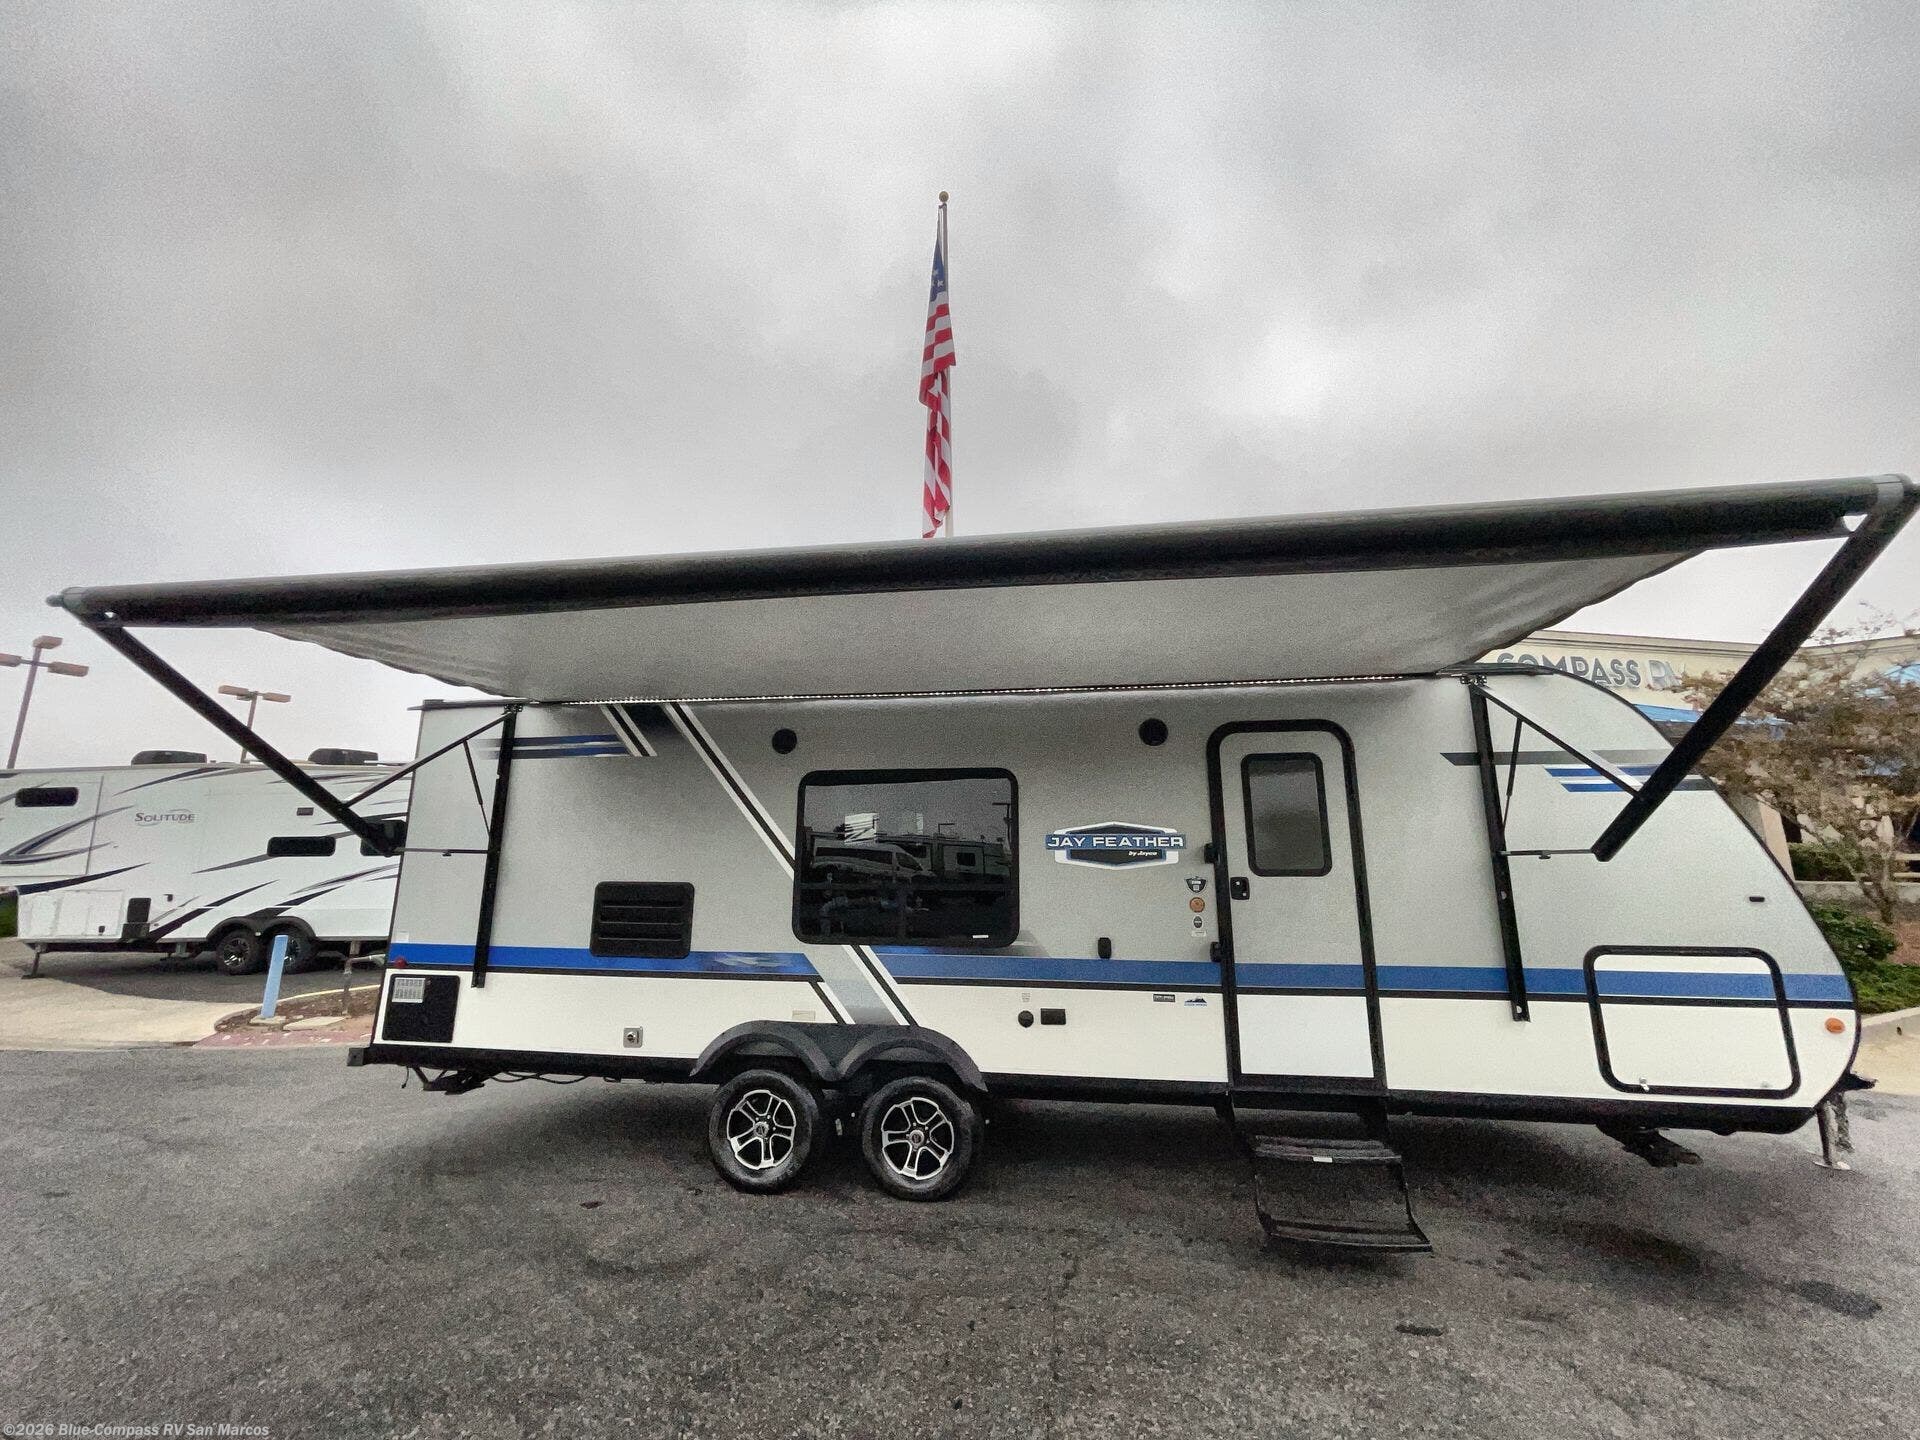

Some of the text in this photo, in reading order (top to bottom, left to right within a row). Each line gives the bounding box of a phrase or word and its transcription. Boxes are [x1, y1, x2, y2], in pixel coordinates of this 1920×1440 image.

[134, 812, 195, 822] SOLITUDE
[1047, 837, 1184, 847] JAY FEATHER
